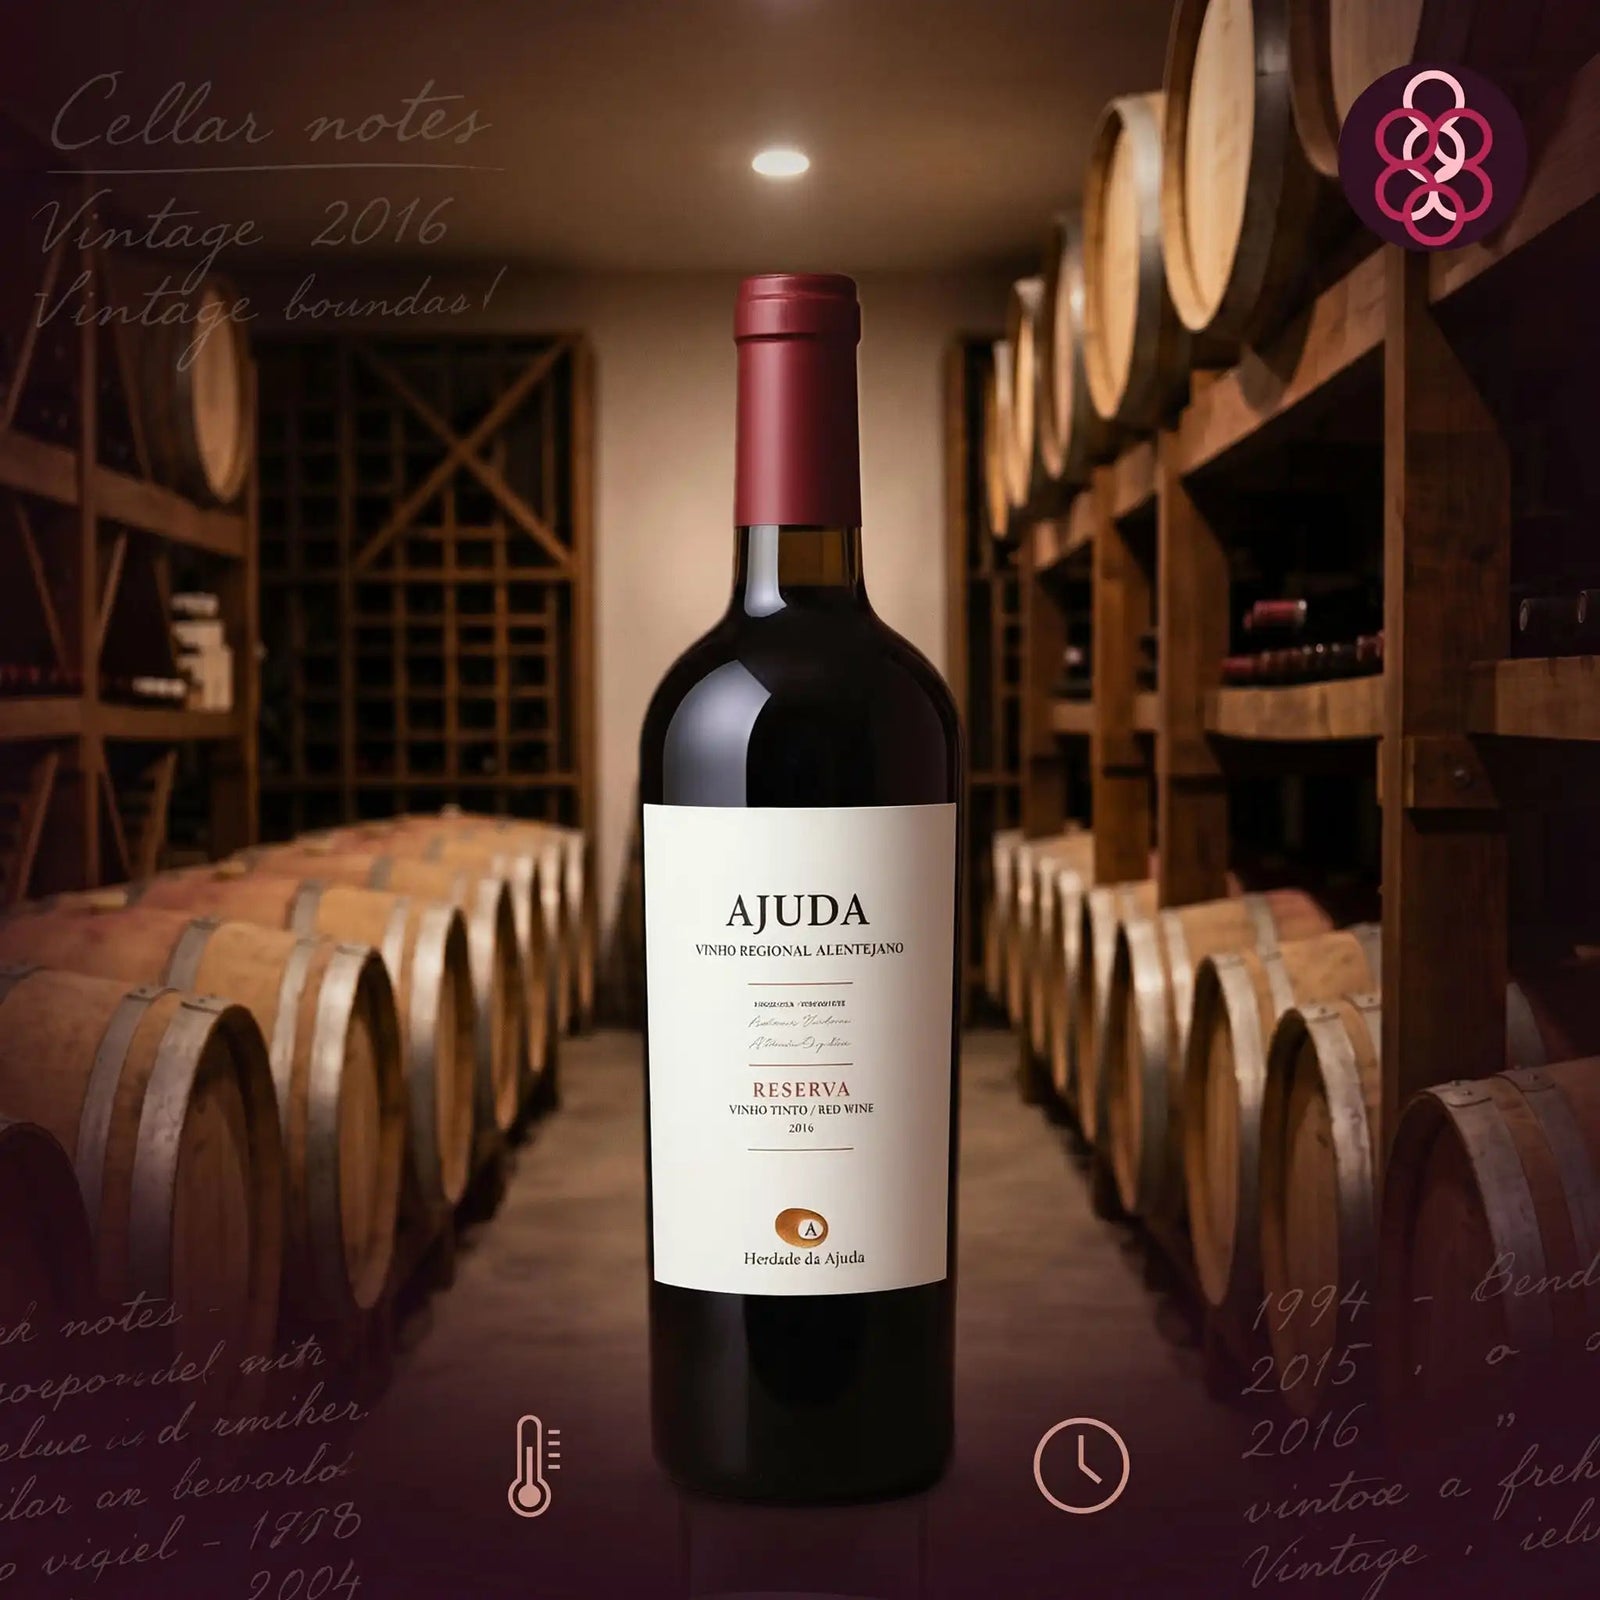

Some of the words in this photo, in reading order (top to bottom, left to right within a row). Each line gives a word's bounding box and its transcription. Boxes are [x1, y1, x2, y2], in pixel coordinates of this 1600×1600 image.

[725, 893, 870, 934] AJUDA
[696, 944, 736, 957] VINHO
[740, 943, 811, 957] REGIONAL
[816, 942, 904, 957] ALENTEJANO
[753, 1081, 850, 1099] RESERVA
[729, 1104, 768, 1116] VINHO
[770, 1104, 808, 1116] TINTO
[818, 1104, 841, 1115] RED
[844, 1102, 874, 1114] WINE
[788, 1122, 814, 1134] 2016
[805, 1222, 817, 1236] A
[805, 1252, 820, 1265] da
[824, 1250, 865, 1268] Ajuda
